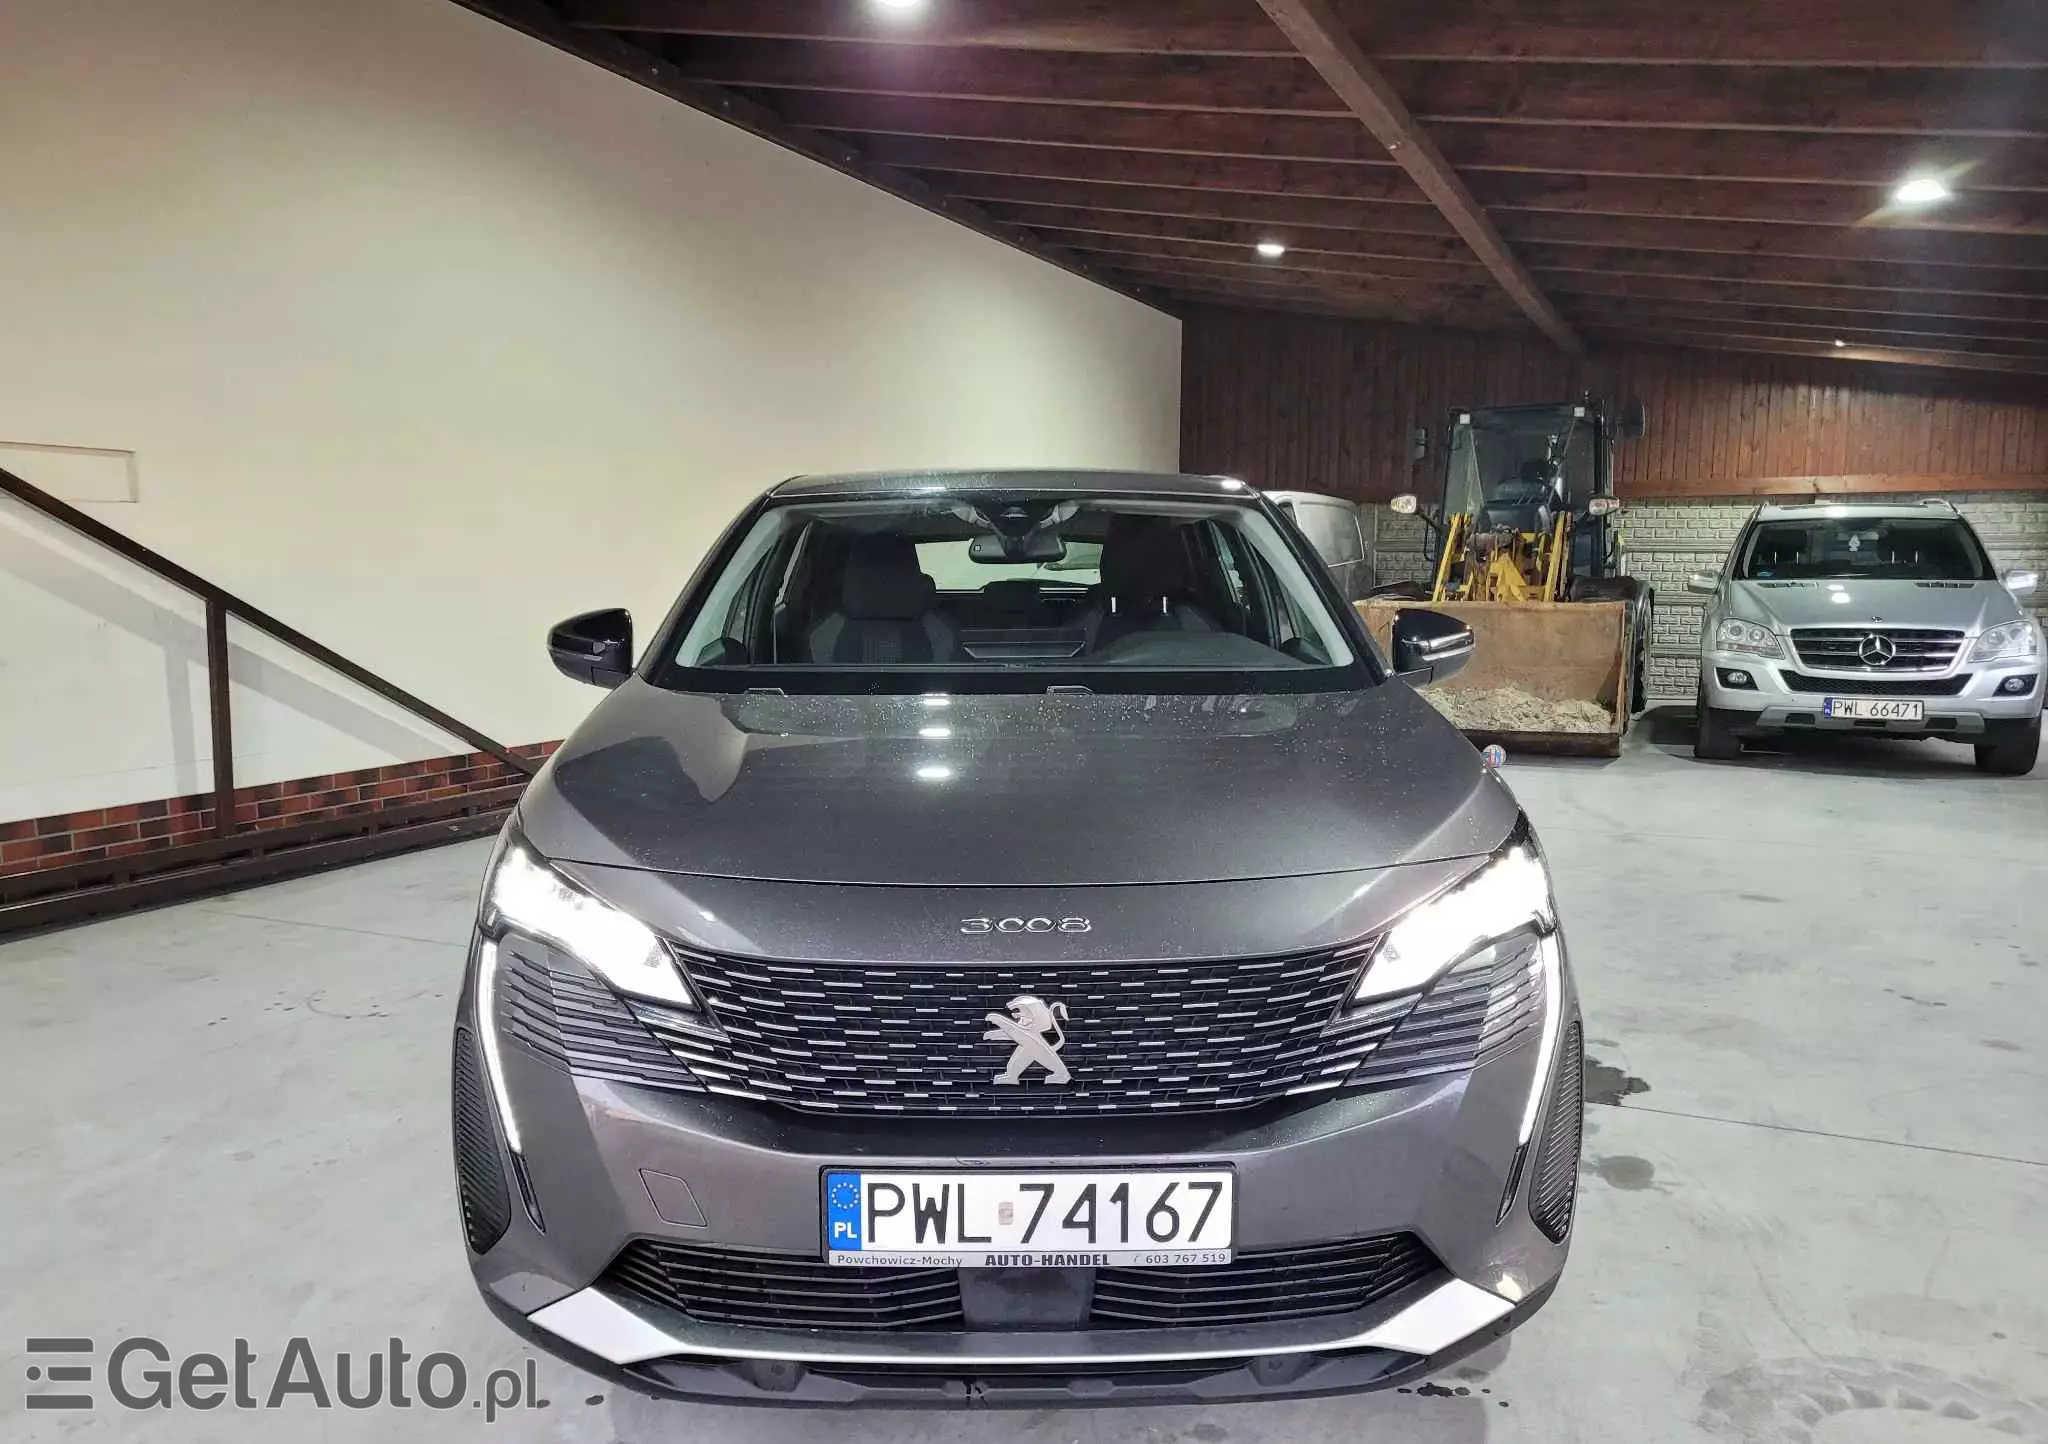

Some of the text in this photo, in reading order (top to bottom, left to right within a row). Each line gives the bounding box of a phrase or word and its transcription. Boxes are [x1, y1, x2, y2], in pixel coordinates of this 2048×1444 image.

[1833, 701, 1919, 718] PWL 66471
[960, 917, 1091, 933] 3008
[867, 1181, 1223, 1244] PWL 74167
[834, 1221, 858, 1239] PL
[985, 1254, 1110, 1266] AUTO-HANDEL
[1146, 1253, 1226, 1265] 603 767 519
